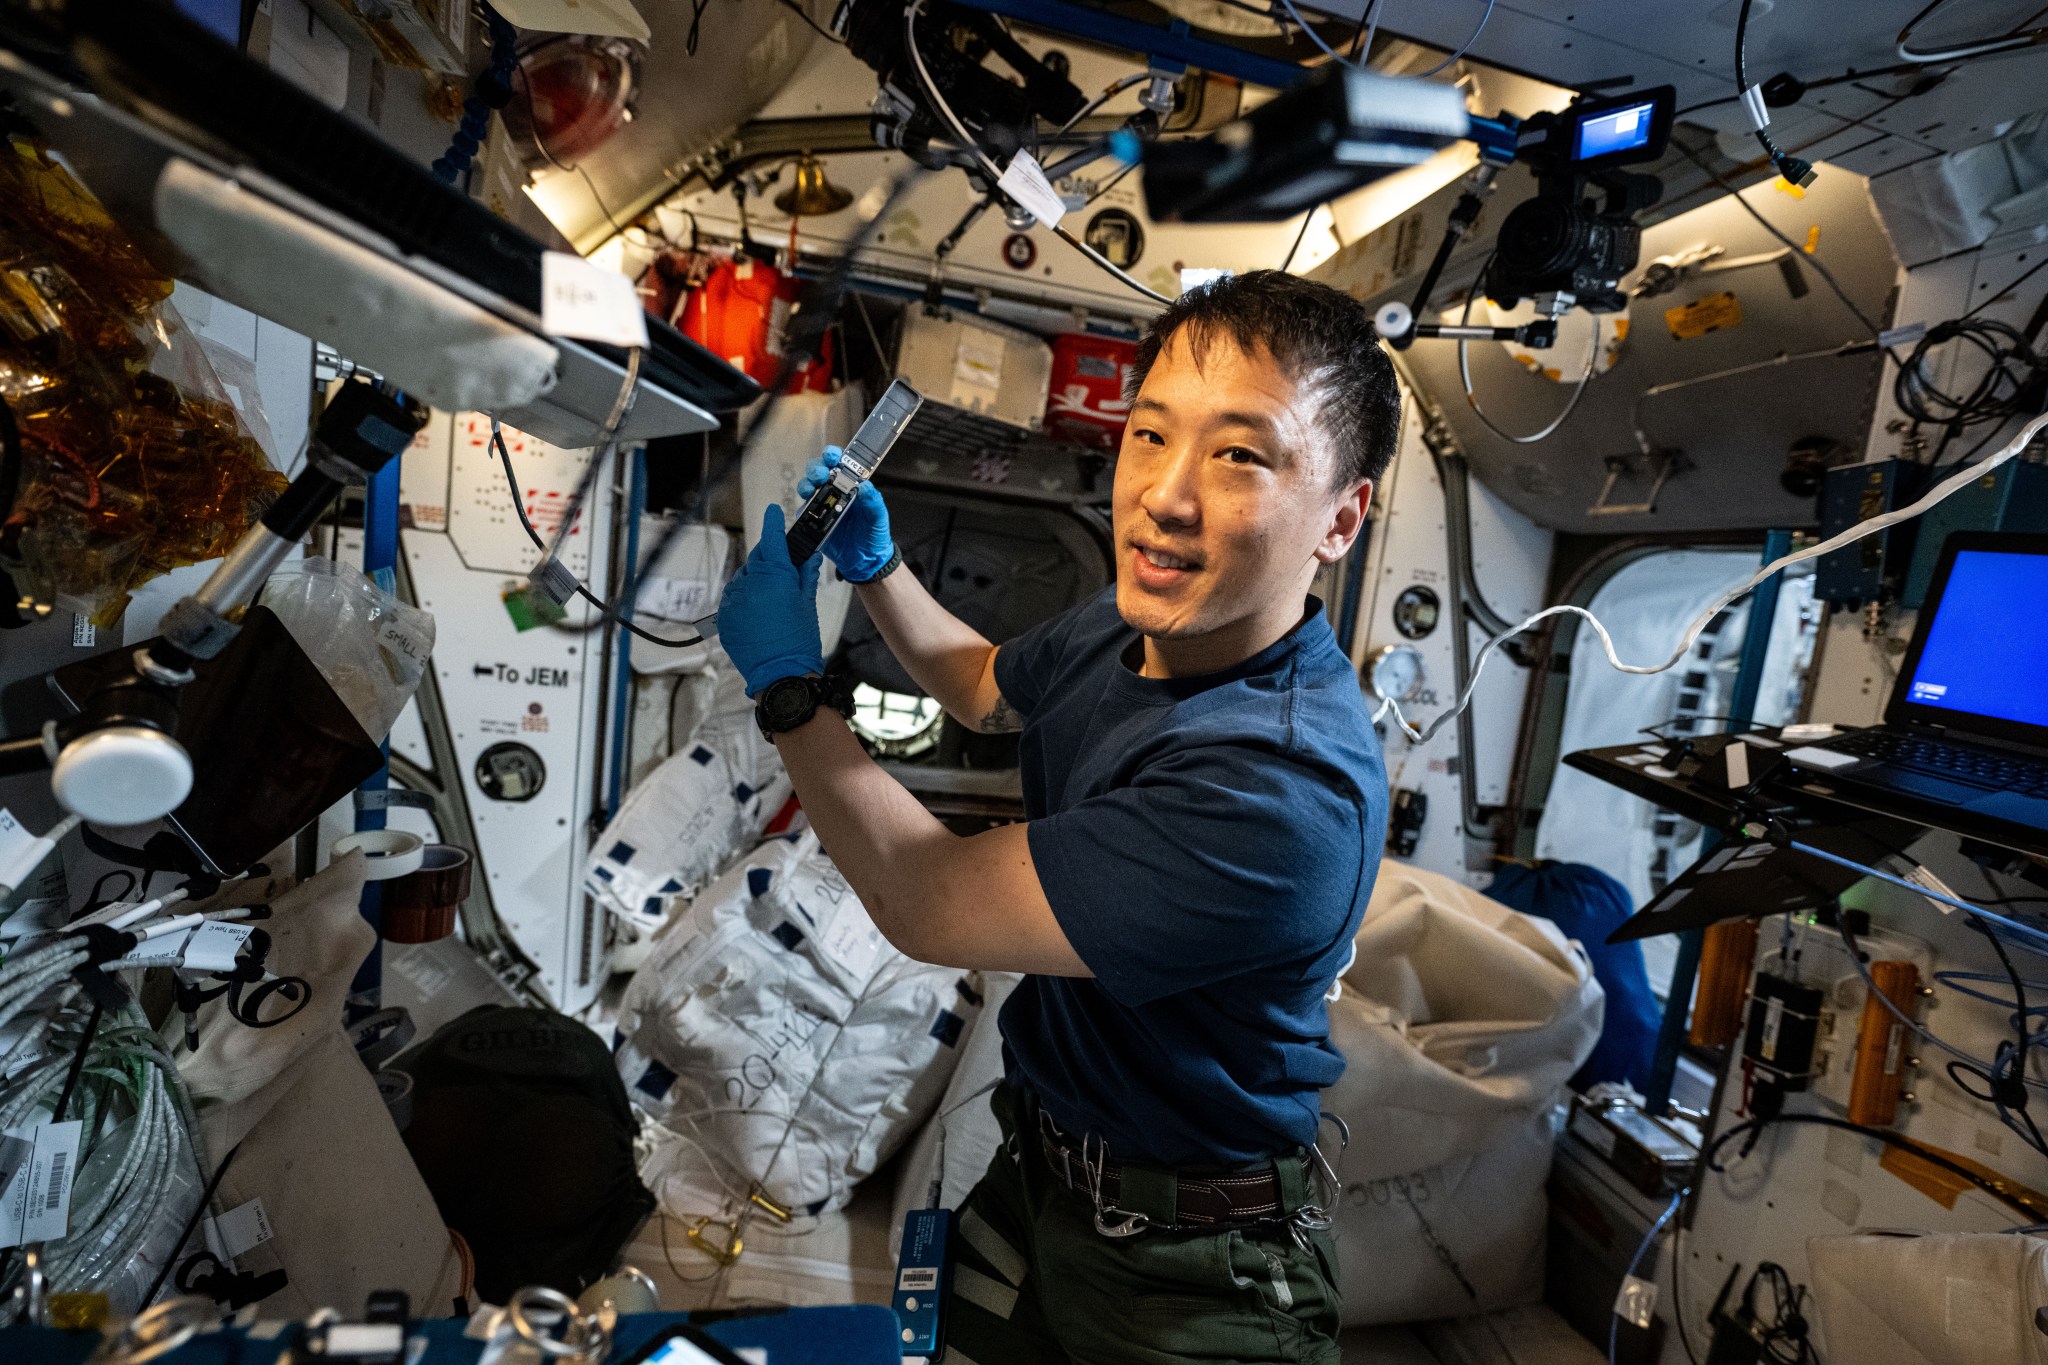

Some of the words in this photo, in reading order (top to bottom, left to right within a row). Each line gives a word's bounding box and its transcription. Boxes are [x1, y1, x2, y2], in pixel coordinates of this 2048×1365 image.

[384, 629, 416, 660] SMALL
[494, 663, 519, 684] To
[525, 667, 569, 687] JEM
[214, 925, 228, 934] Type
[228, 927, 241, 935] USB
[17, 1169, 27, 1192] USB-C
[14, 1200, 23, 1221] USB-C
[256, 1233, 263, 1242] P1
